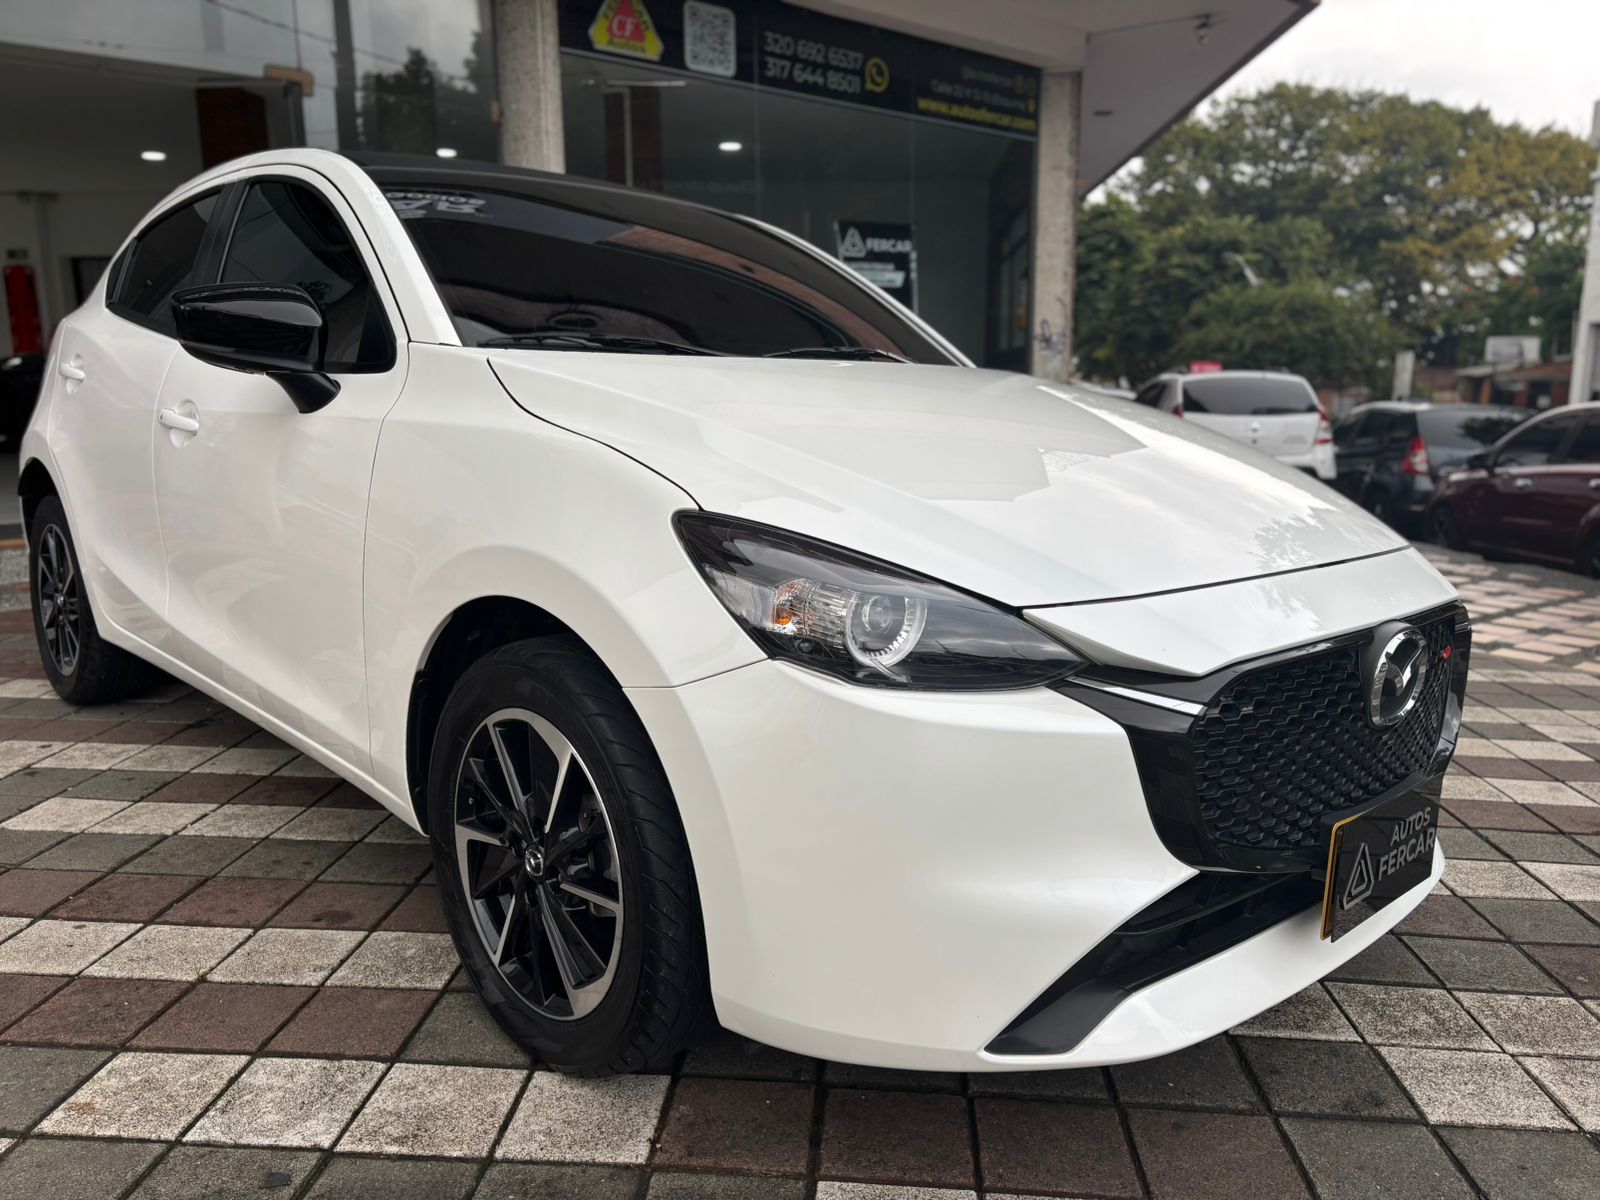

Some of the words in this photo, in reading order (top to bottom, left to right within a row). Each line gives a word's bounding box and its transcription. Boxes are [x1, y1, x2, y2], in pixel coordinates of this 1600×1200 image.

[610, 13, 638, 38] CF
[763, 30, 795, 57] 320
[763, 56, 792, 80] 317
[793, 63, 825, 87] 644
[1390, 806, 1431, 847] AUTOS
[1377, 827, 1436, 882] FERCAR
